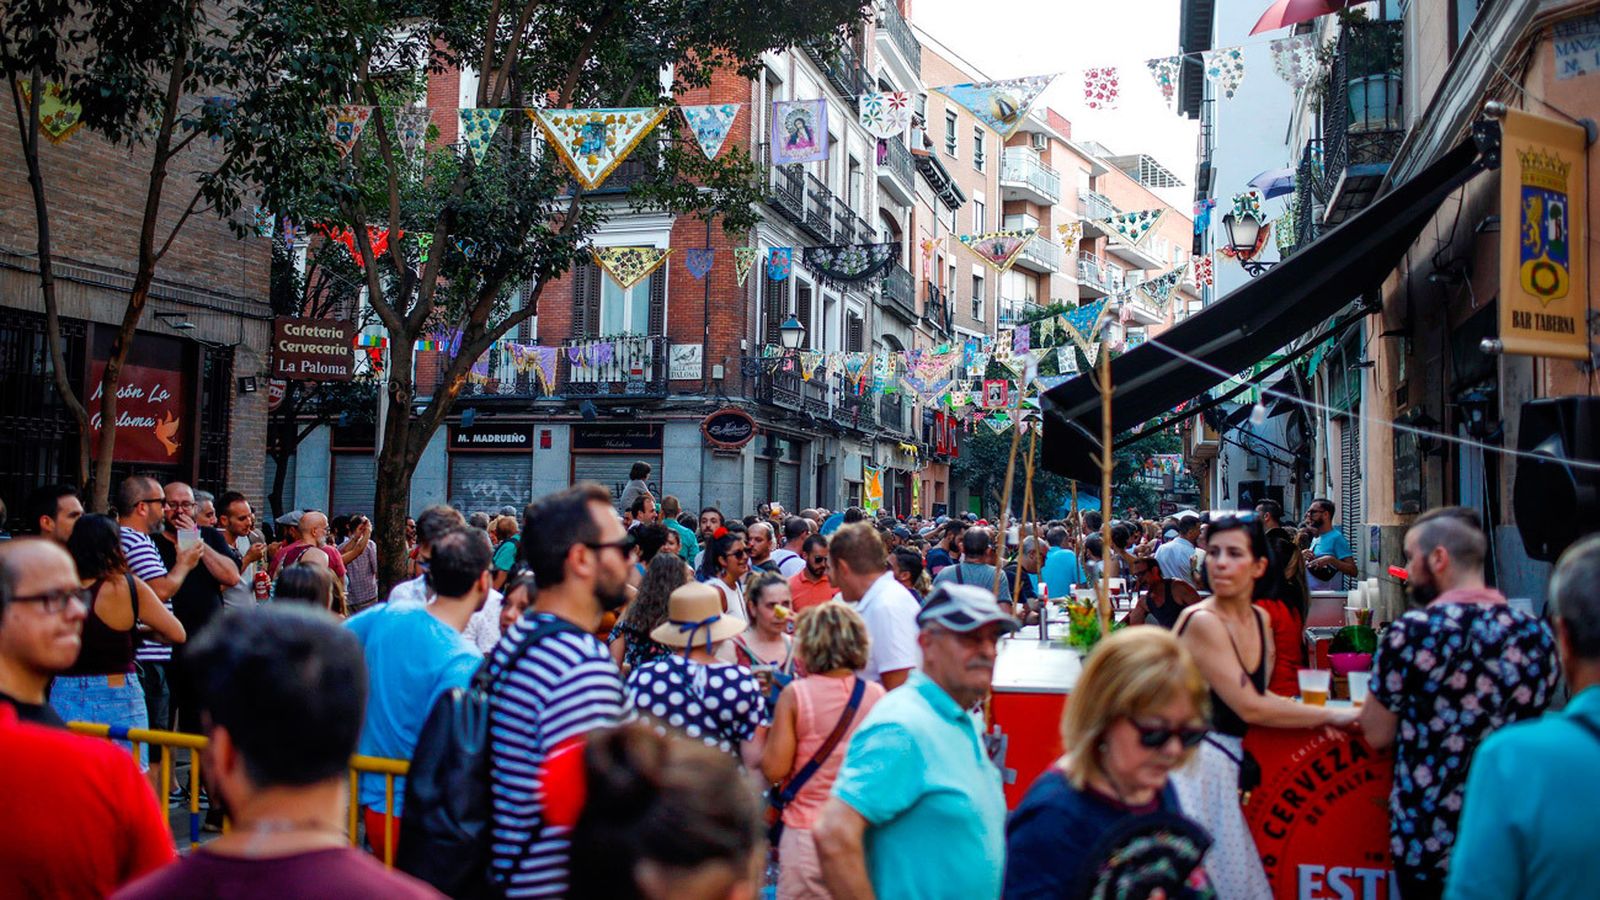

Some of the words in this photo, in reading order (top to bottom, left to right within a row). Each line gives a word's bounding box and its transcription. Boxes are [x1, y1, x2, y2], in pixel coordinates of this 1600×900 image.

[1555, 35, 1600, 58] MANZ
[284, 323, 344, 339] Cafeteria
[1512, 310, 1531, 330] BAR
[1534, 312, 1575, 335] TABERNA
[279, 340, 348, 356] Cerveceria
[279, 359, 296, 372] La
[301, 360, 347, 375] Paloma
[90, 381, 144, 400] Msón
[147, 383, 171, 403] La
[90, 411, 156, 430] Ploma
[457, 434, 470, 443] M.
[472, 432, 527, 443] MADRUEÑO
[1262, 738, 1370, 840] CERVEZA
[1305, 805, 1326, 826] DE
[1323, 768, 1376, 805] MALTA
[1297, 863, 1401, 900] EST
